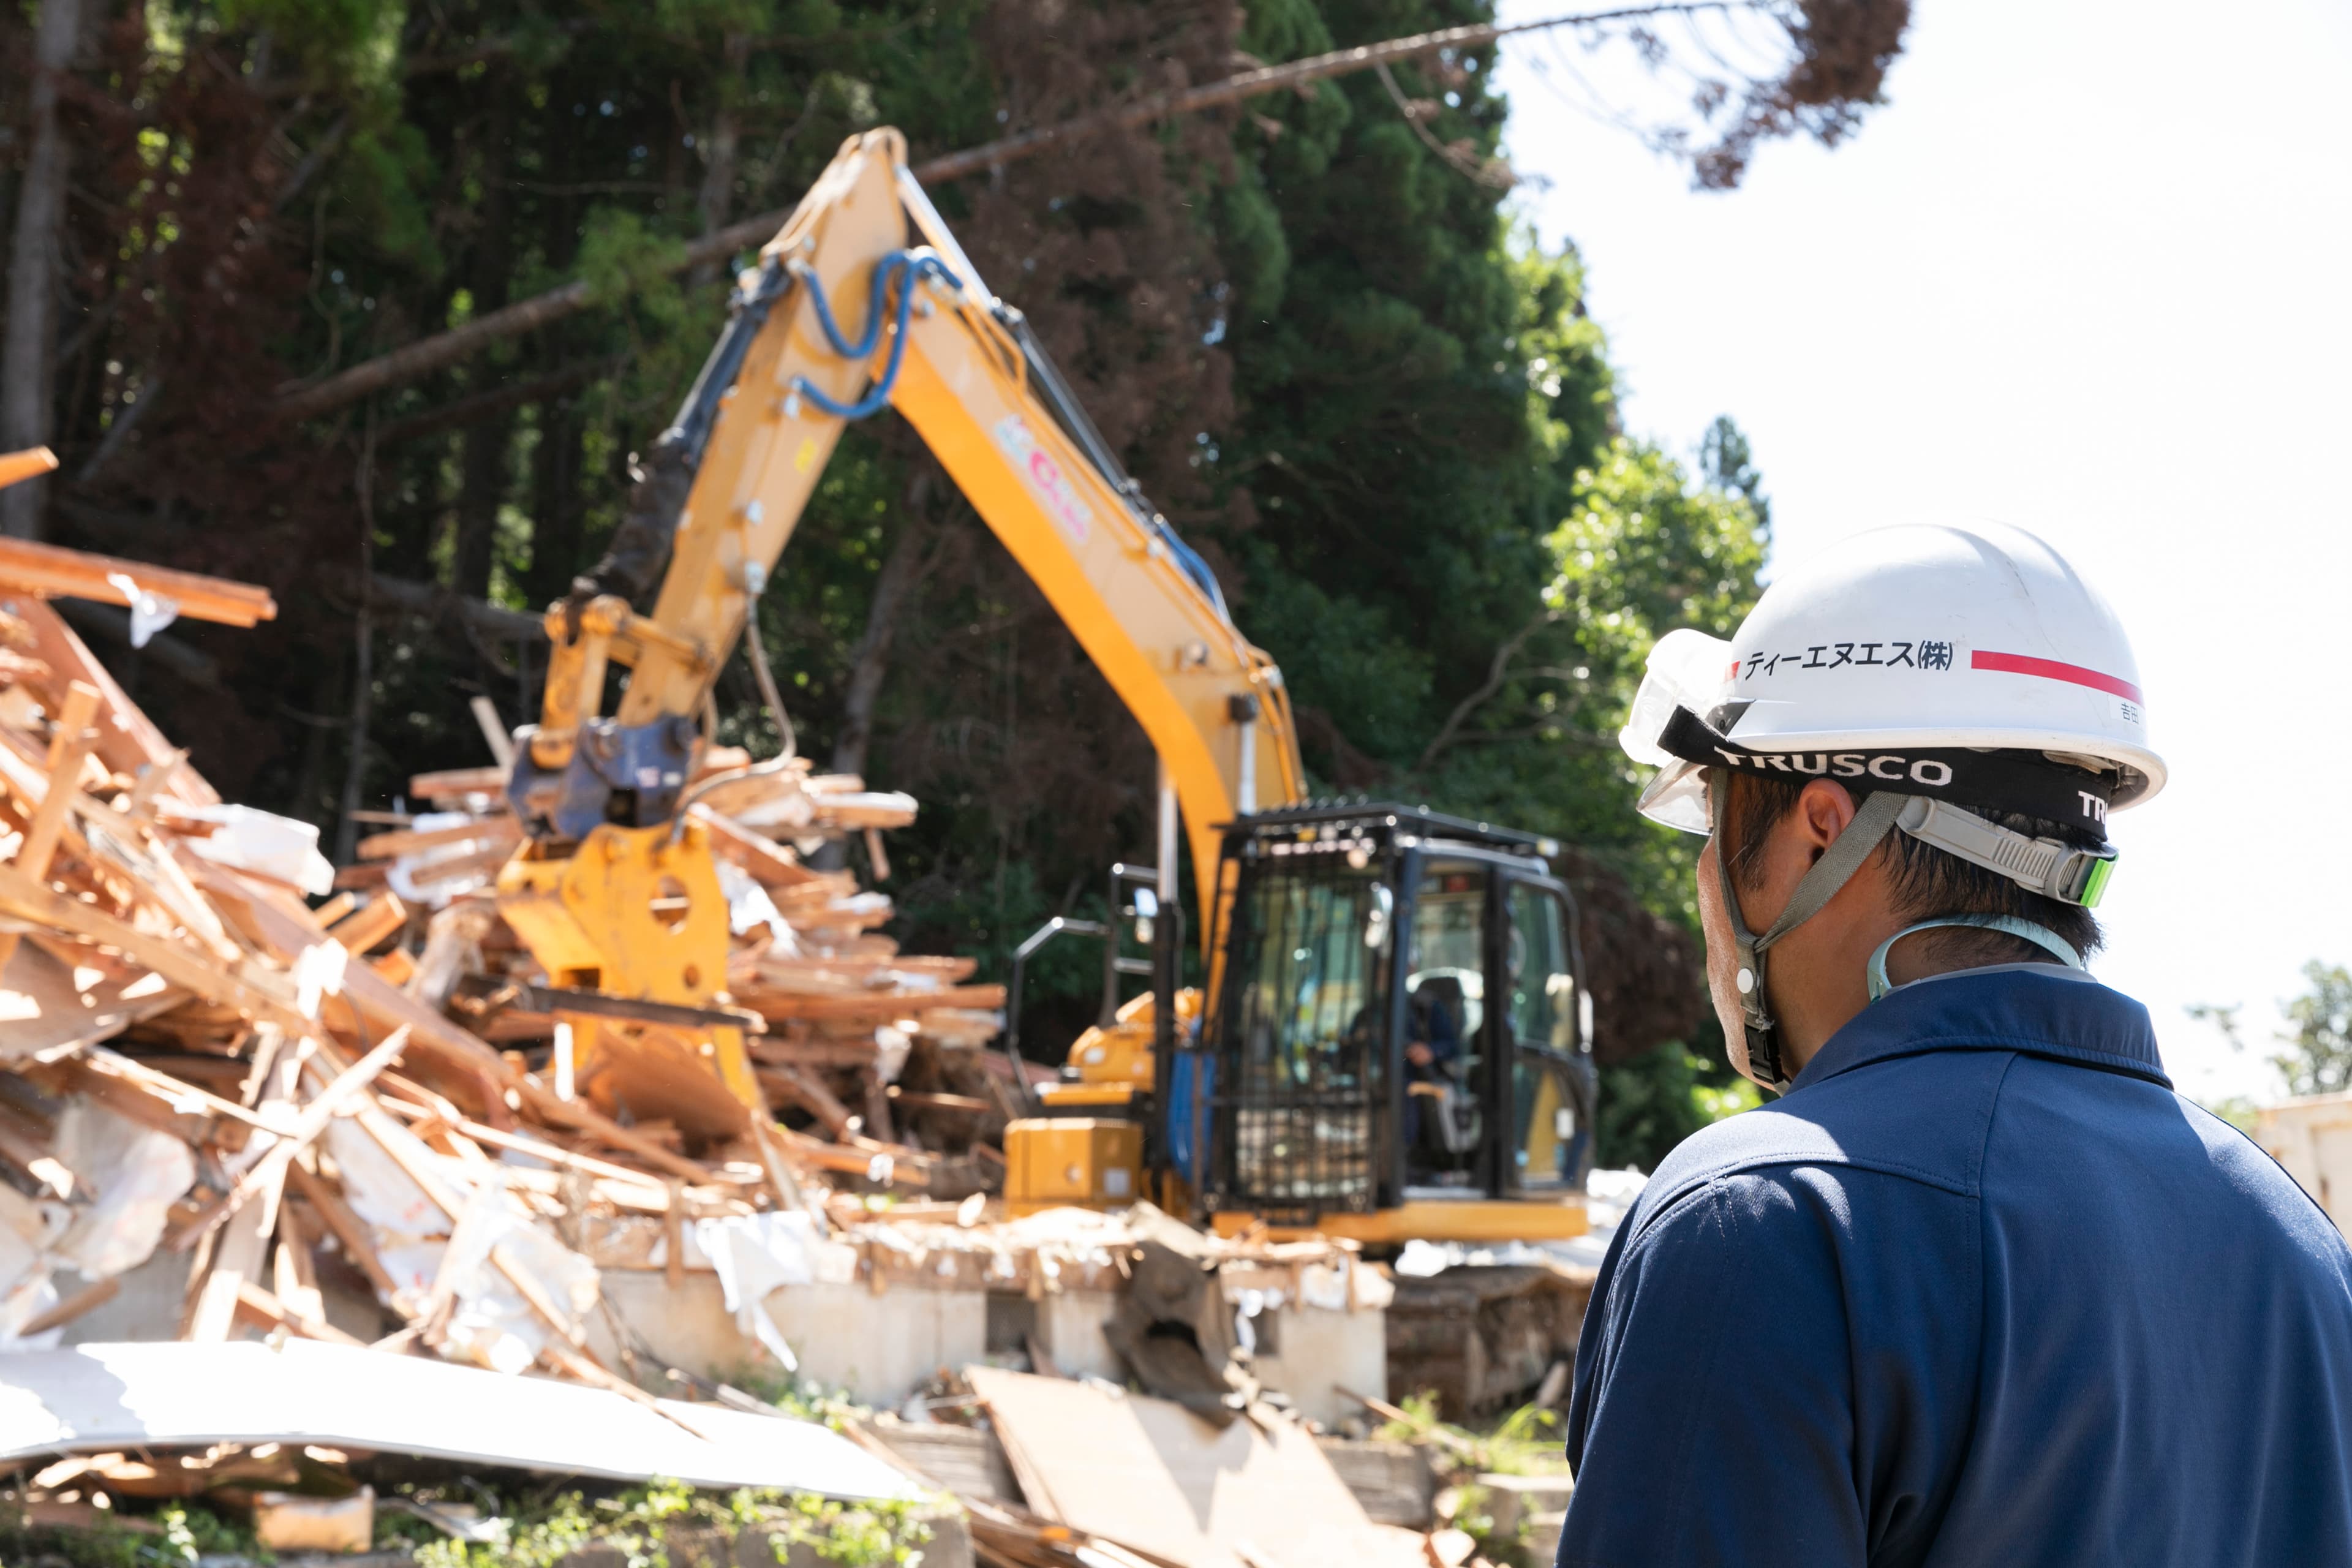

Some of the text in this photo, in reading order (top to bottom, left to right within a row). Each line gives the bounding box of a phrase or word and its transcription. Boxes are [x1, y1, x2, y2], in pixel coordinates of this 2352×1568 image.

[1745, 640, 1953, 680] ティーエヌエス(株)
[1714, 745, 1953, 786] TRUSCO
